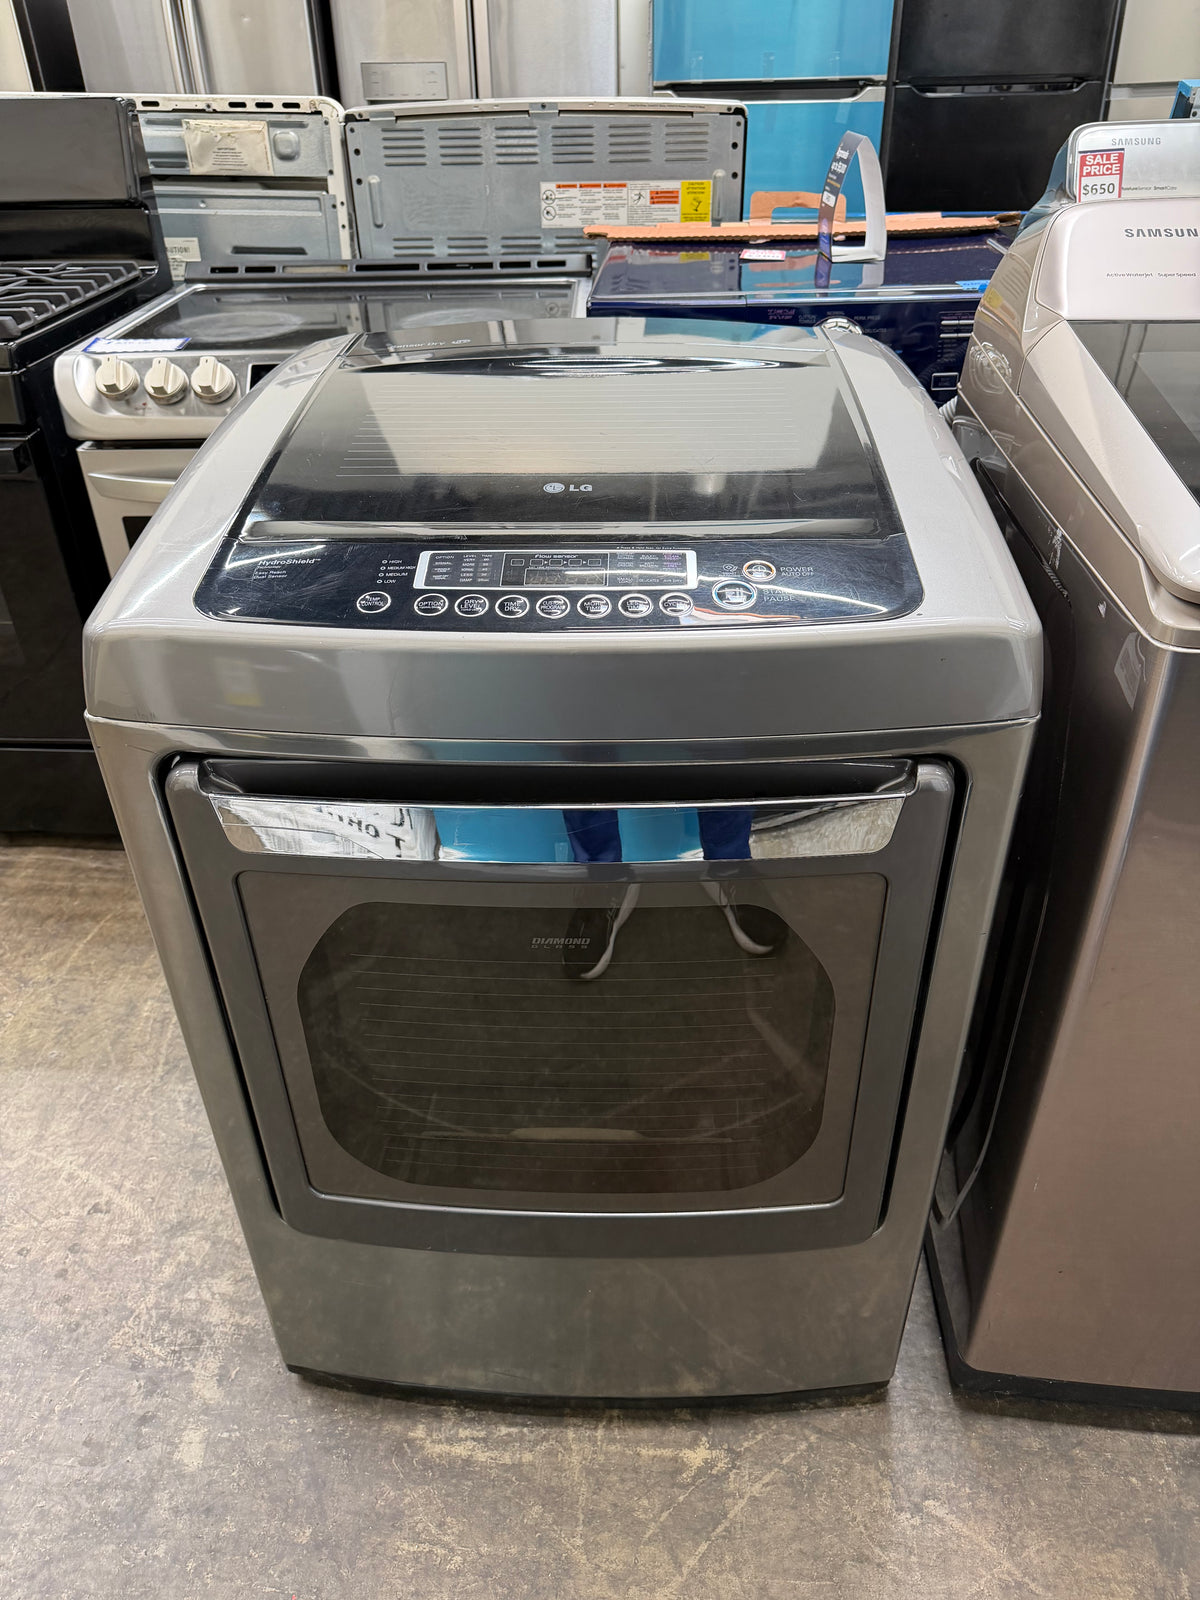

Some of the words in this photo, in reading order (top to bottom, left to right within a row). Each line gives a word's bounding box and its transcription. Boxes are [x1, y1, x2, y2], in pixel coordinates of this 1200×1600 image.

[1111, 137, 1161, 146] SAMSUNG
[1085, 153, 1119, 165] SALE
[1082, 164, 1121, 176] PRICE
[1082, 182, 1115, 196] $650
[1124, 228, 1199, 238] SAMSUN
[569, 484, 593, 492] LG
[531, 937, 591, 945] DIAMOND
